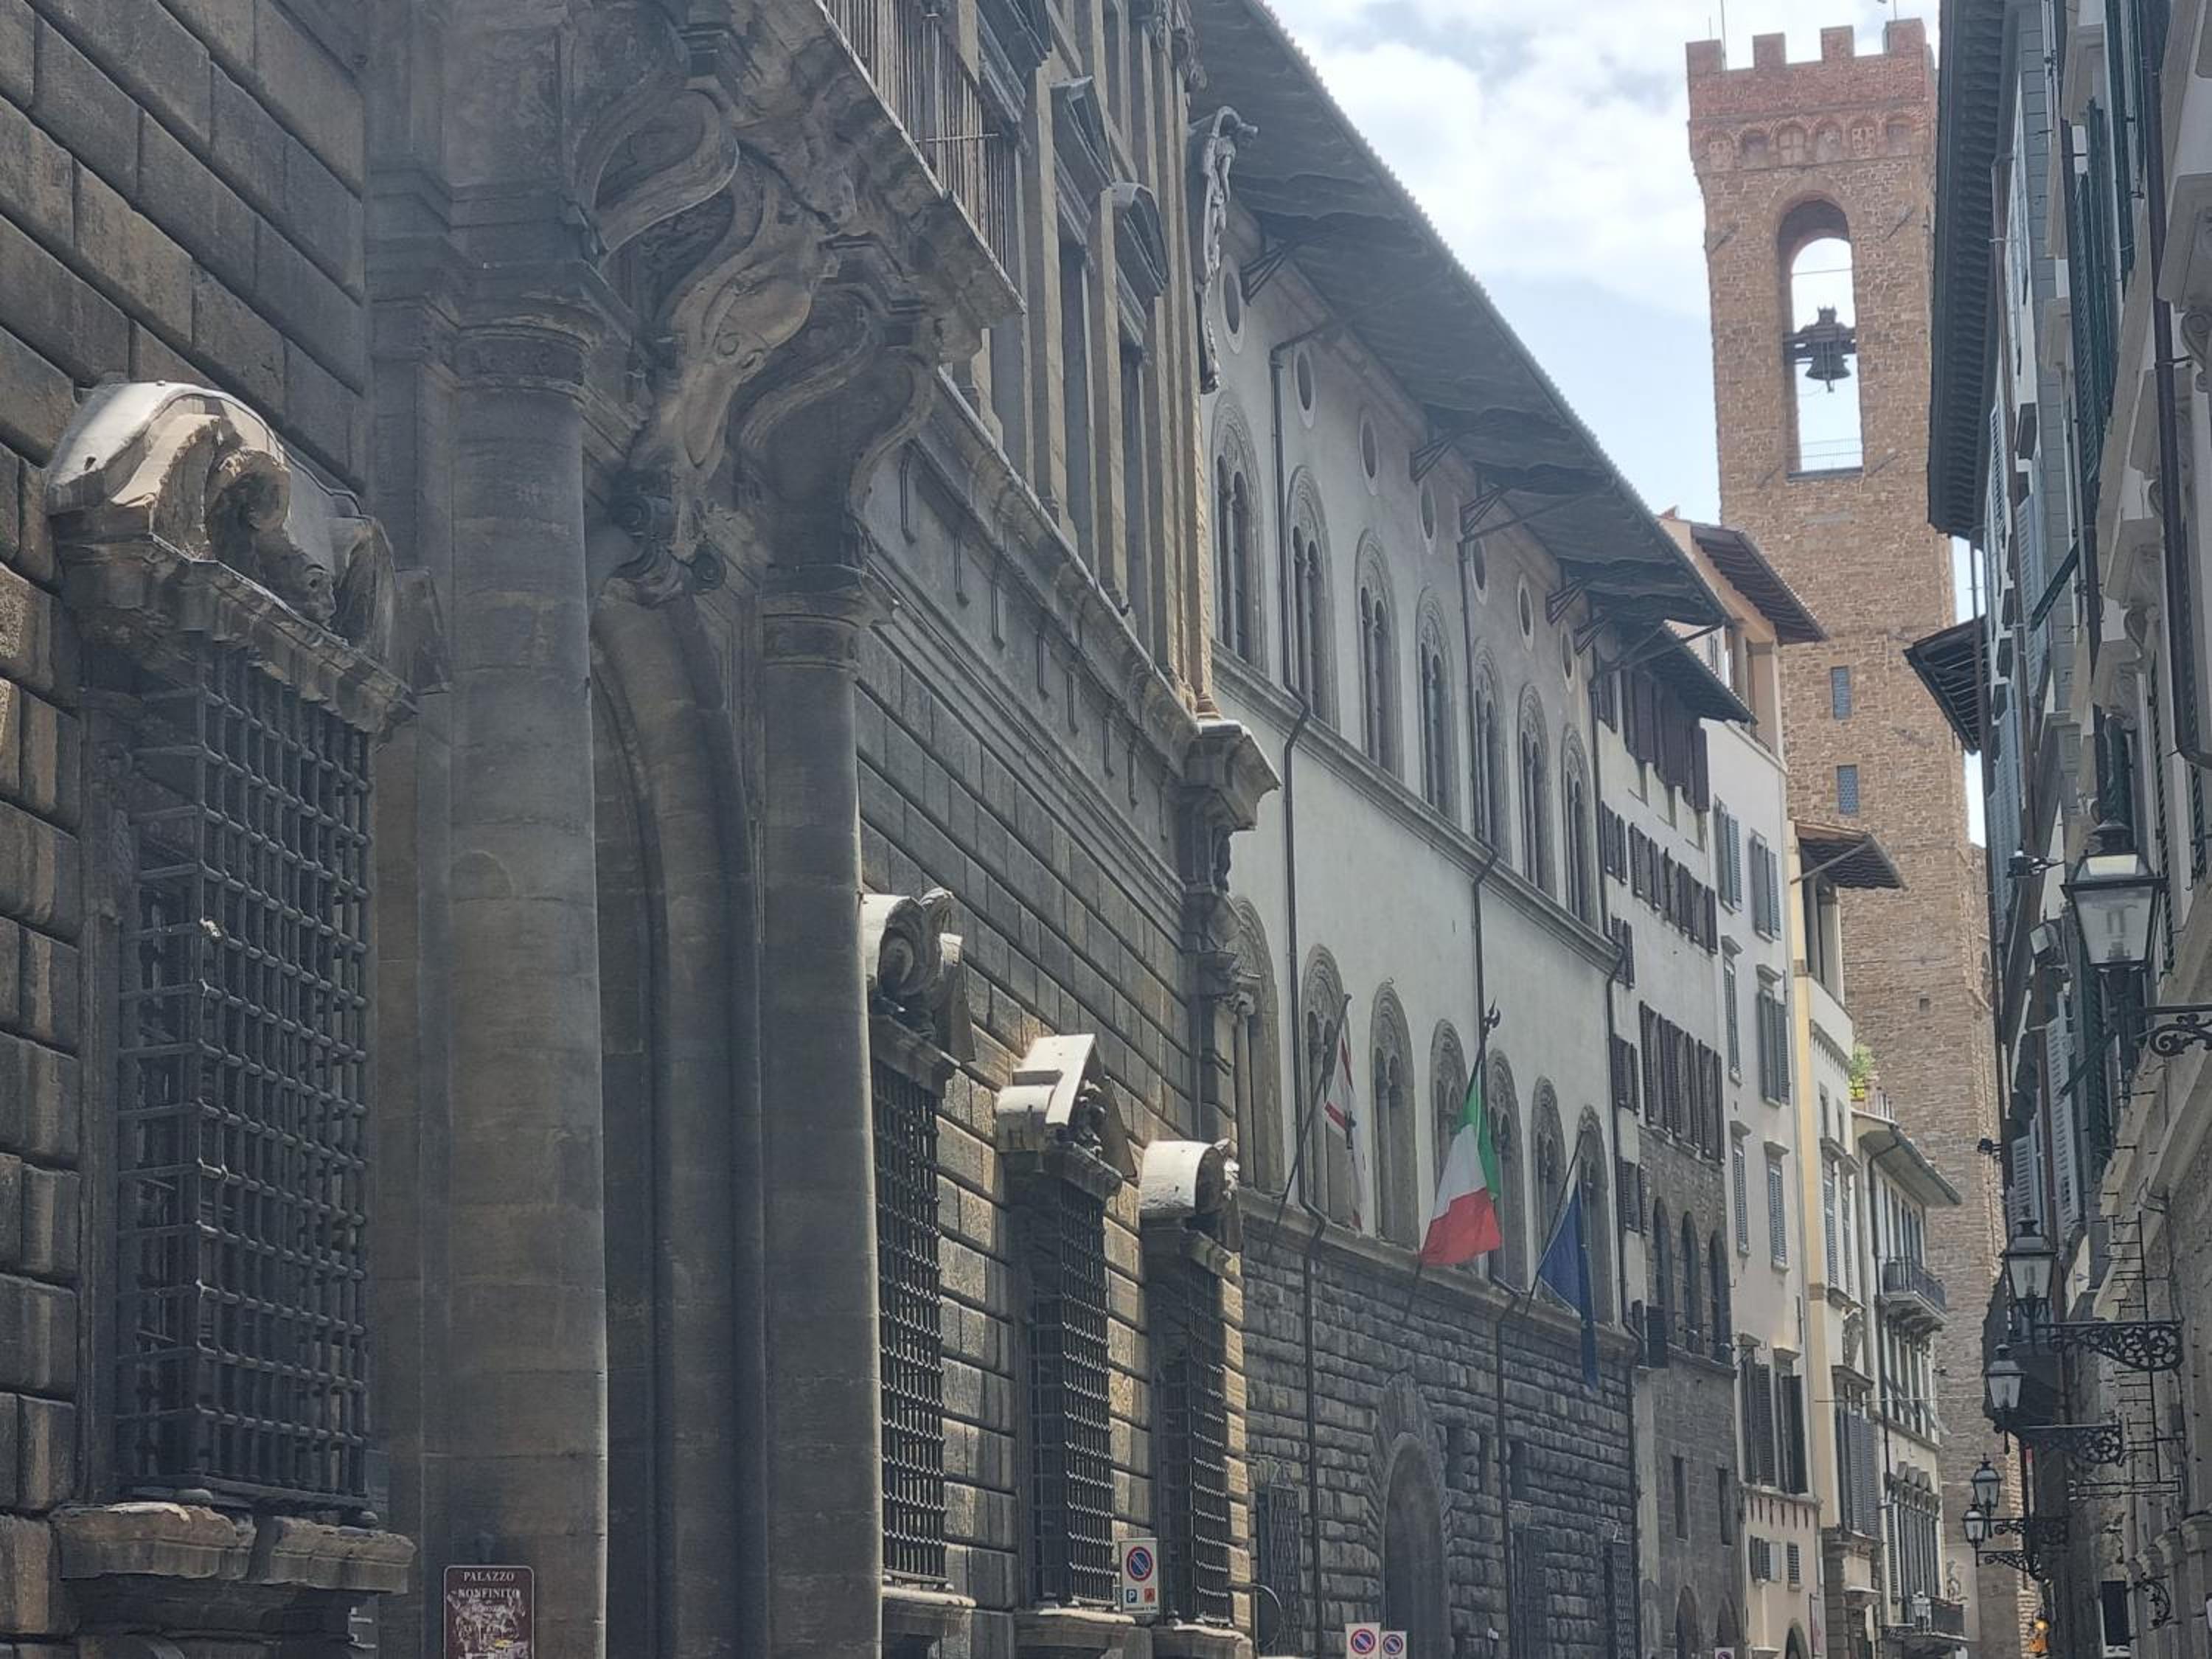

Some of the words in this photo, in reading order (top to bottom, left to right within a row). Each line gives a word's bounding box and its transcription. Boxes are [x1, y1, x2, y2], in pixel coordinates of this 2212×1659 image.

[463, 1571, 514, 1582] PALAZZO
[458, 1587, 521, 1599] NONFINITO
[1128, 1591, 1136, 1602] P
